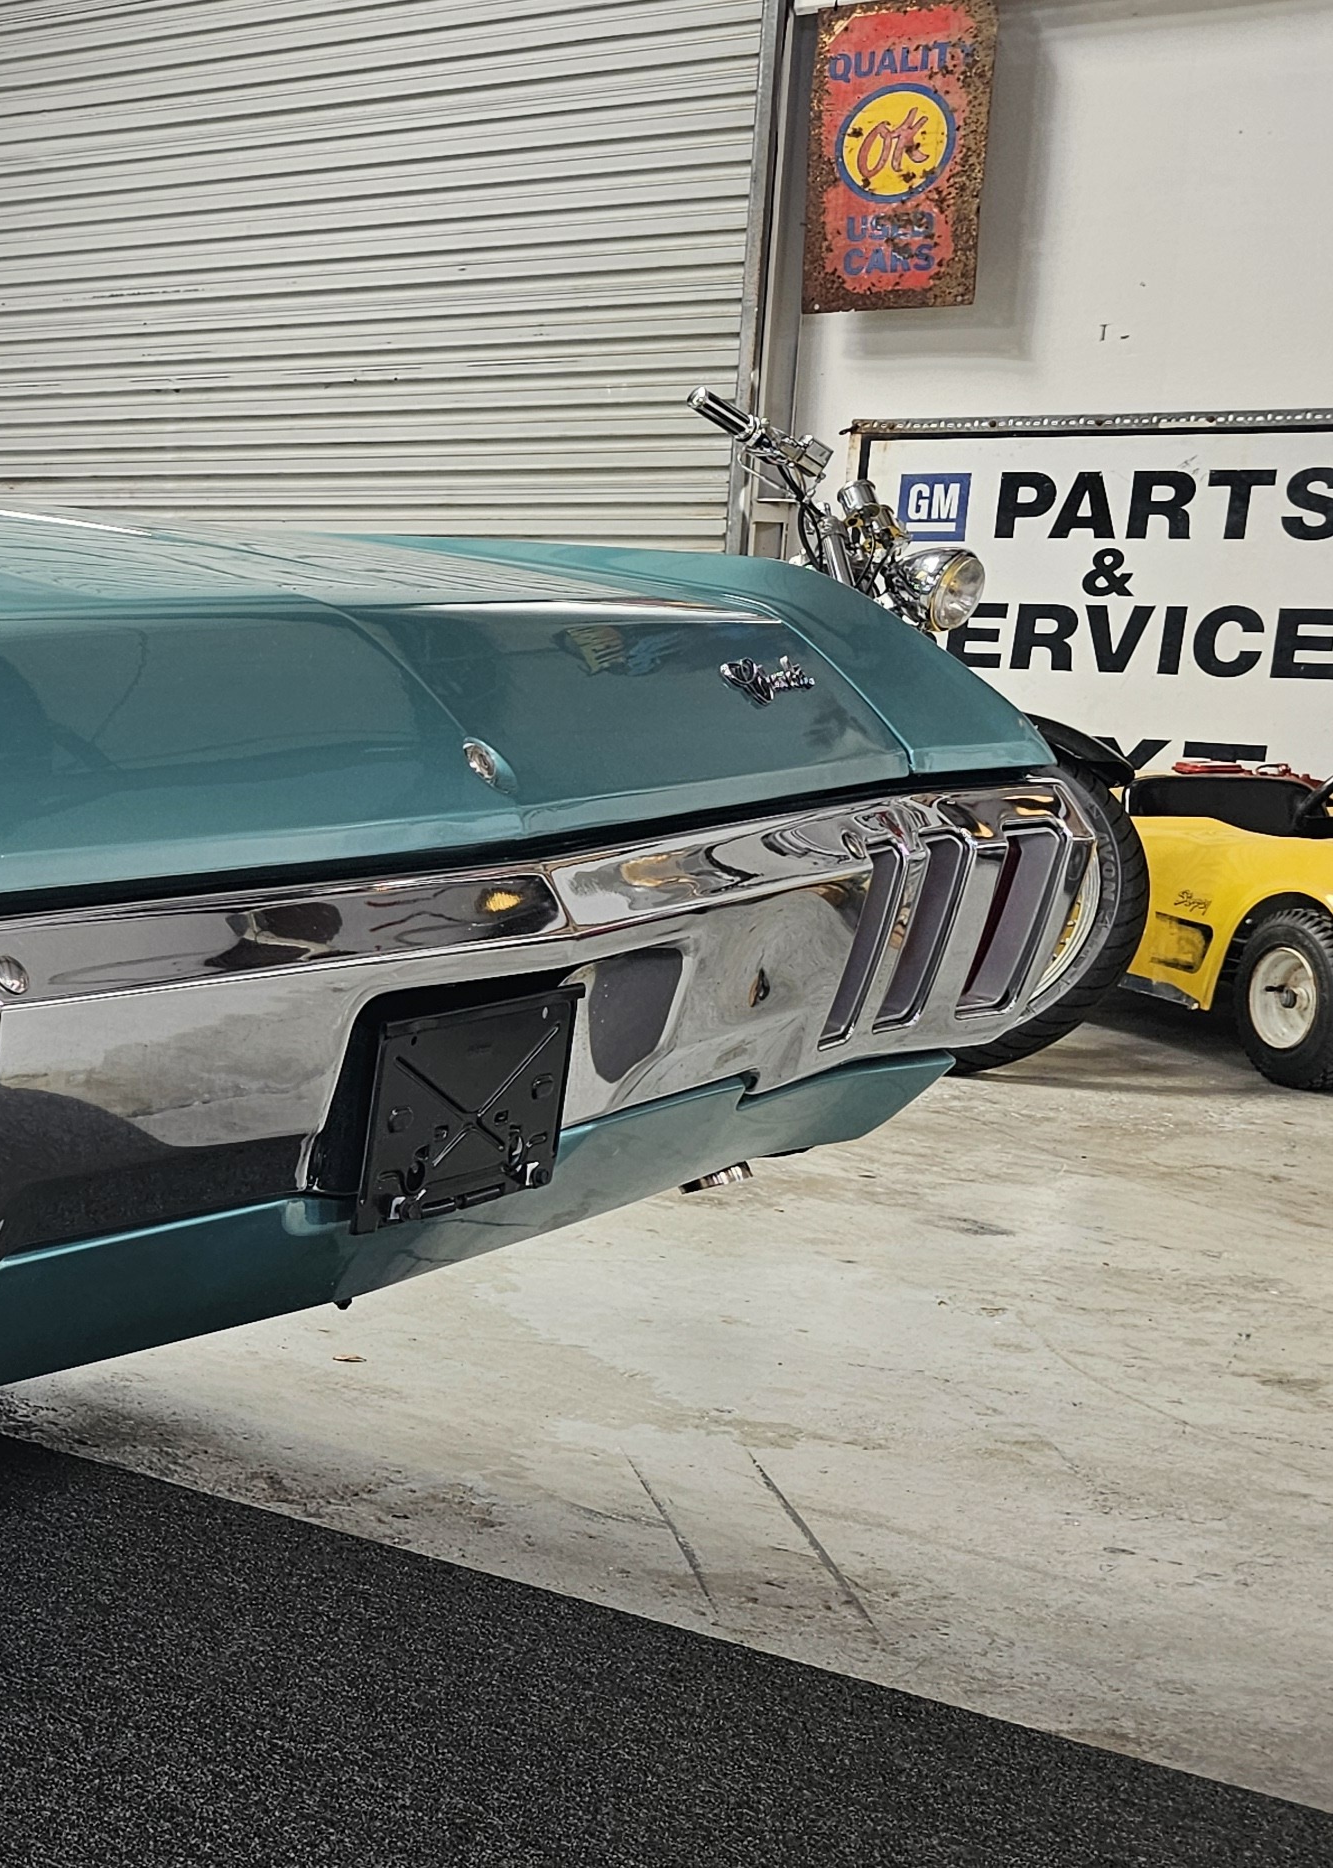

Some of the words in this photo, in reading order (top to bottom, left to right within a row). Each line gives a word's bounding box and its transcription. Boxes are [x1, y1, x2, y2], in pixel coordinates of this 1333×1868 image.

[828, 41, 977, 83] QUALITY
[857, 107, 930, 178] OK
[846, 212, 936, 243] USED
[843, 244, 936, 277] CARS
[907, 481, 959, 521] GM
[994, 467, 1333, 541] PARTS
[1081, 548, 1134, 597] &
[944, 602, 1333, 681] ERVICE
